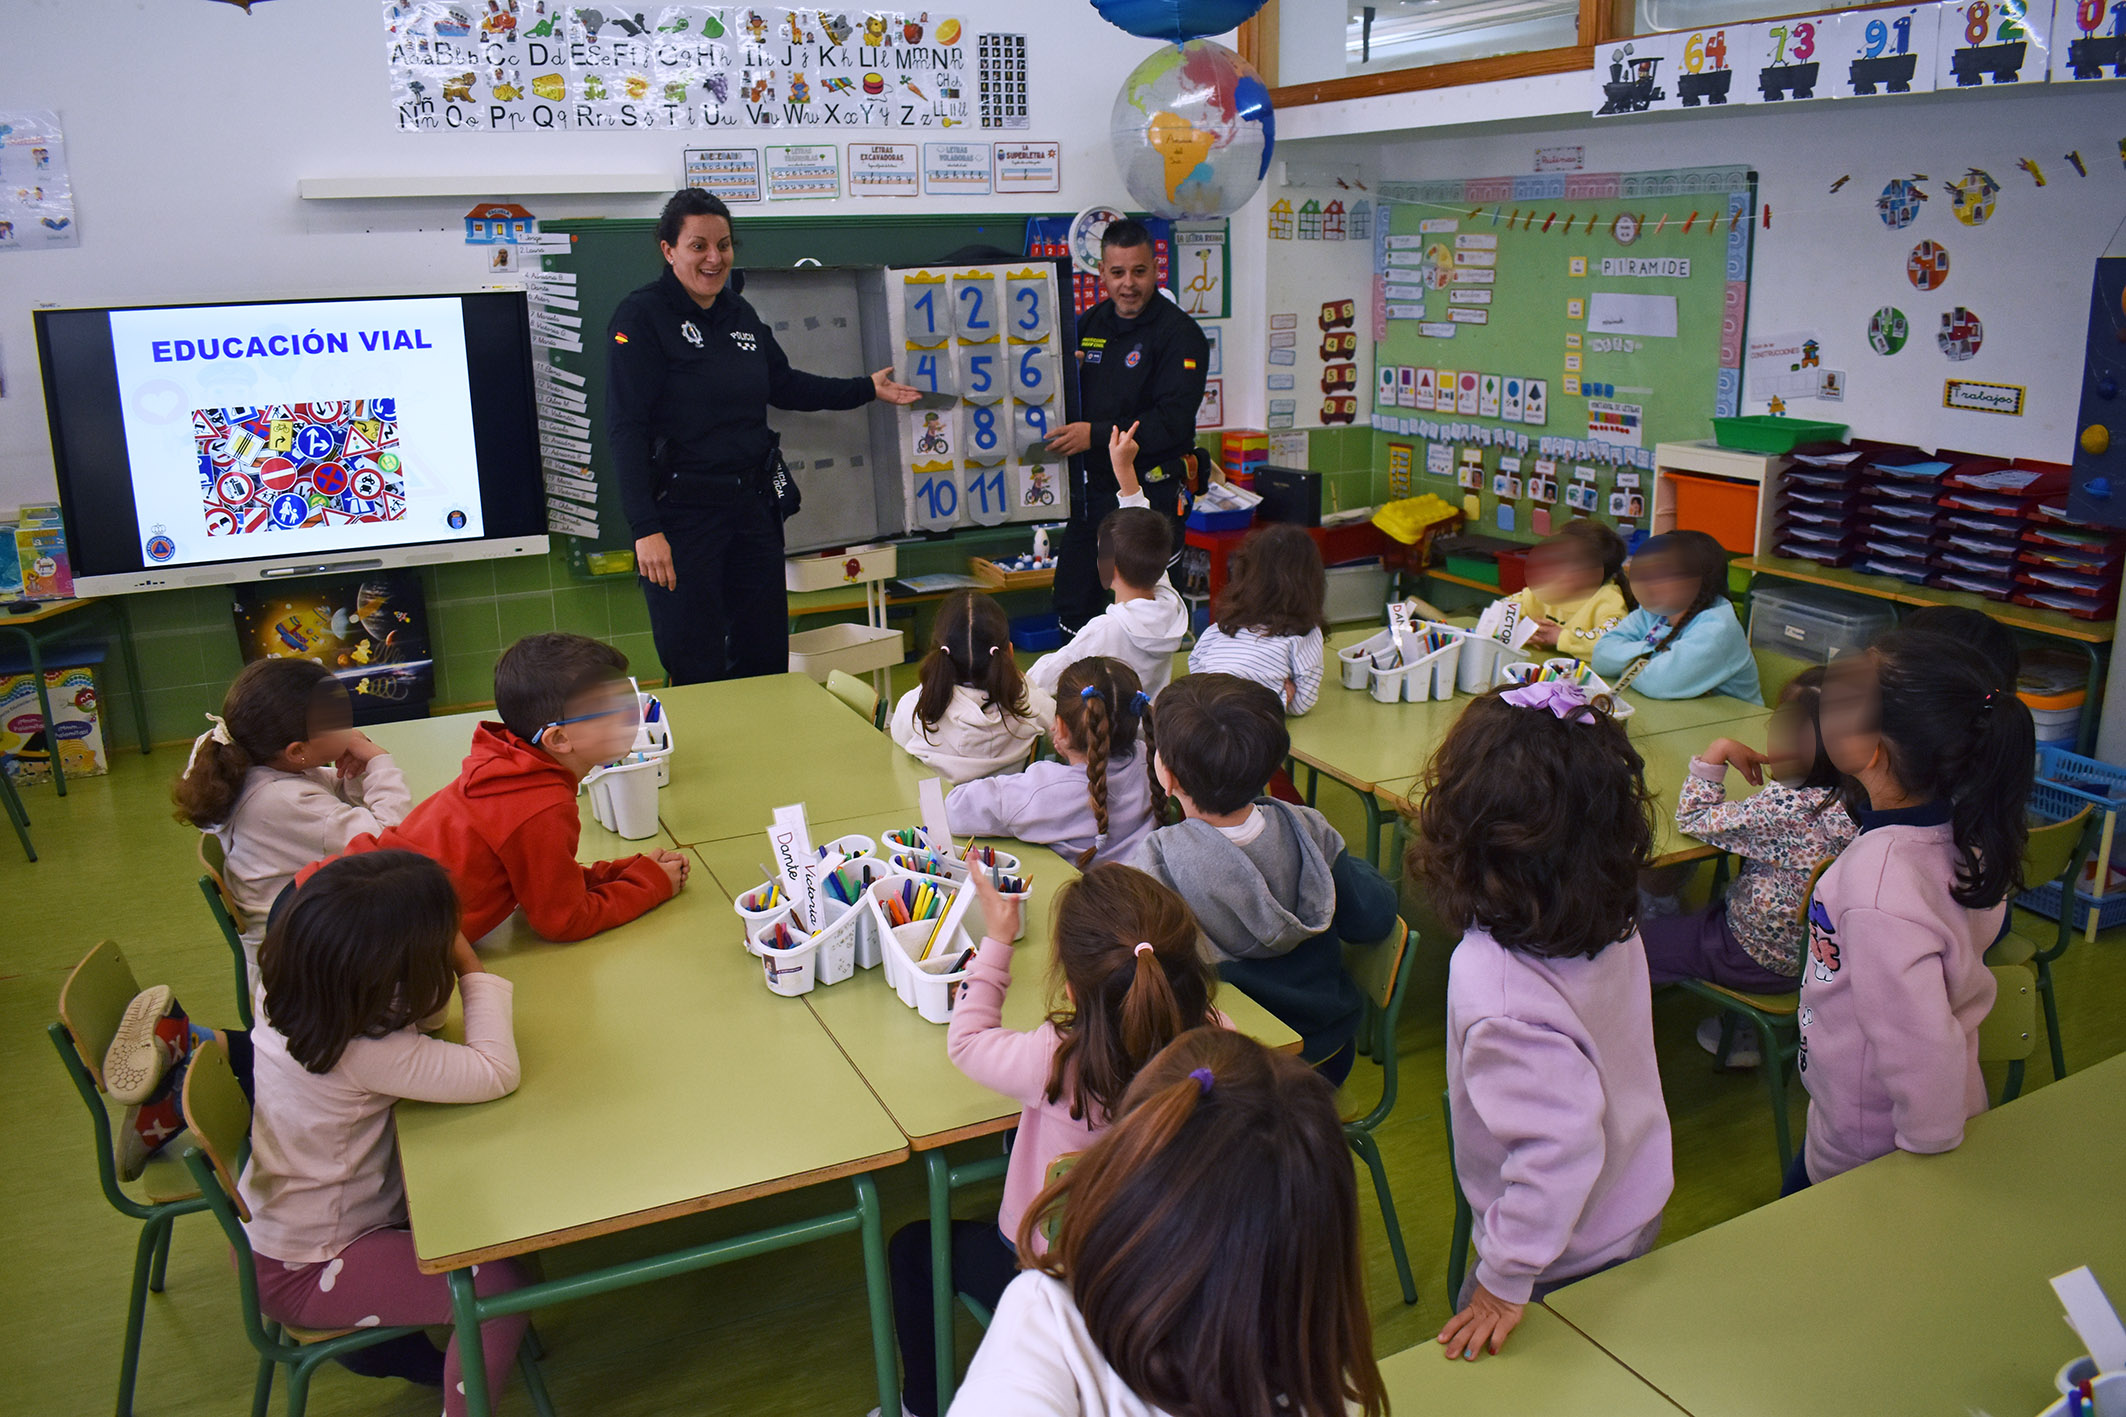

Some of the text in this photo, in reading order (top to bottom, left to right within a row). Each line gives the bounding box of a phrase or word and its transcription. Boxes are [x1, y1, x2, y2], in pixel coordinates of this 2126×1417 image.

[1769, 22, 1815, 62] 73
[1864, 16, 1911, 57] 91
[1965, 0, 2027, 44] 82
[1684, 30, 1727, 73] 64
[946, 146, 968, 154] LETRAS
[1604, 260, 1688, 275] PIRAMIDE
[914, 289, 935, 333] 1
[960, 286, 990, 329] 2
[1016, 288, 1040, 330] 3
[1327, 305, 1350, 317] 3 5
[151, 328, 433, 363] EDUCACIÓN VIAL
[1328, 337, 1353, 349] 4 6
[916, 356, 937, 393] 4
[971, 356, 992, 392] 5
[1020, 347, 1042, 388] 6
[1329, 371, 1334, 379] 5
[1952, 385, 2013, 406] Trabajos
[973, 407, 997, 450] 8
[1025, 406, 1047, 442] 9
[917, 477, 957, 519] 10
[968, 471, 1006, 513] 11
[1502, 603, 1518, 645] VICTOR
[777, 831, 797, 881] Dante
[805, 864, 818, 927] Victoria
